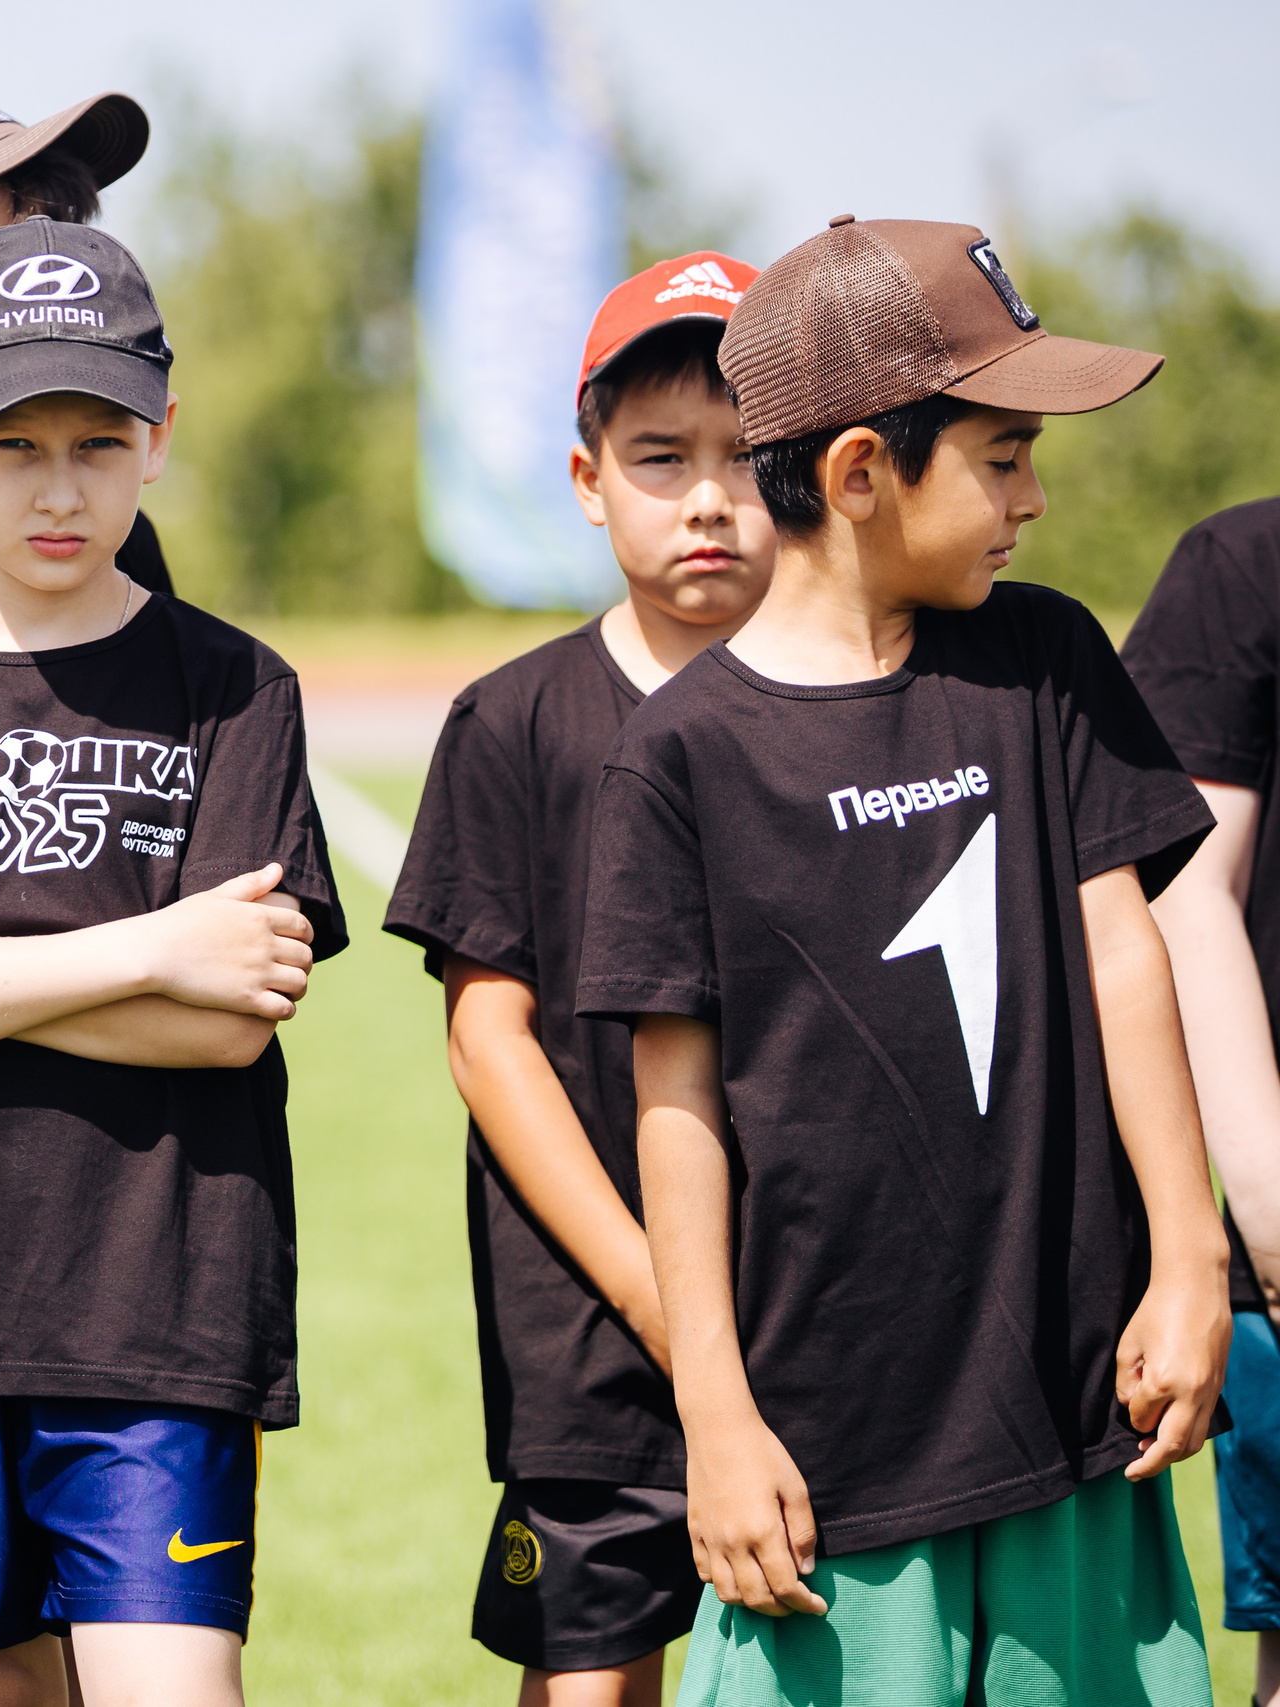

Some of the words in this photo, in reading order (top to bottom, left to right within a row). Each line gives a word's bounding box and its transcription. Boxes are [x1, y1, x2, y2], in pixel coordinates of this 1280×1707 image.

[654, 281, 745, 304] adidas
[827, 765, 990, 831] Первые
[121, 837, 175, 857] ФУТБОЛА
